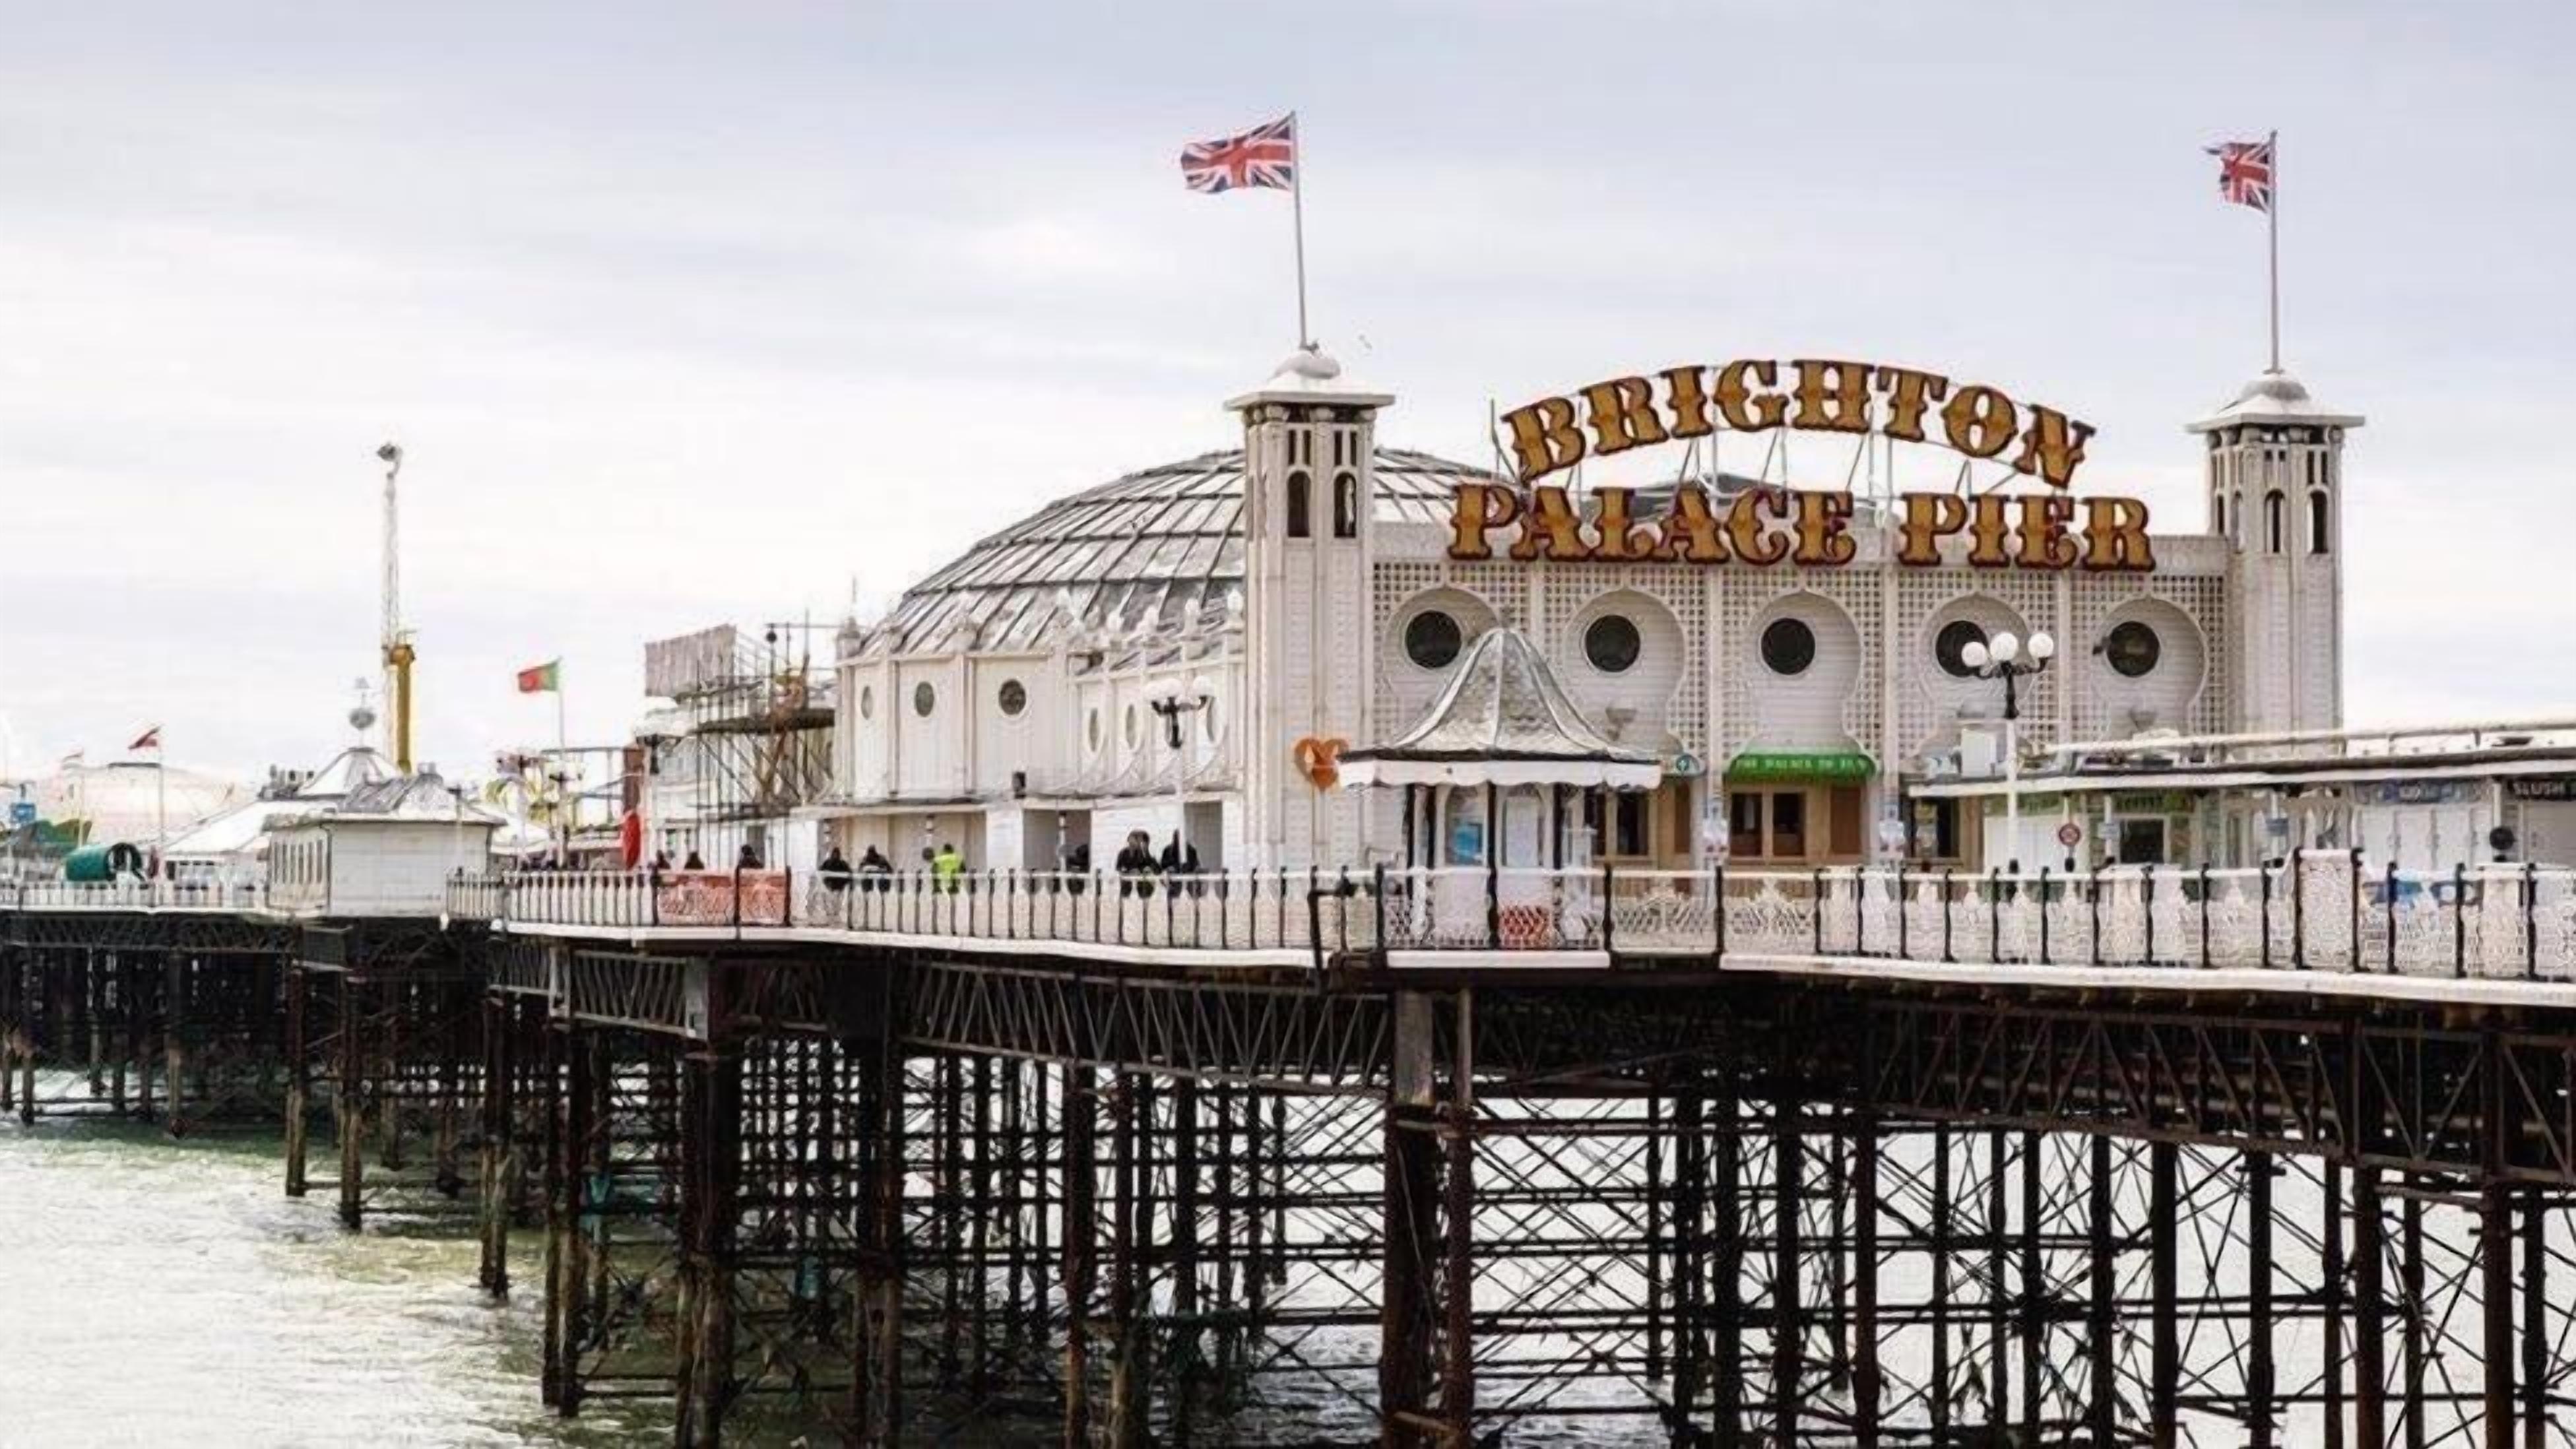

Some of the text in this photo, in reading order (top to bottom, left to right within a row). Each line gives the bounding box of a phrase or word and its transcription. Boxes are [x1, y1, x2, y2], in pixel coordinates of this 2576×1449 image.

[1501, 360, 2096, 488] BRIGHTON
[1448, 483, 2156, 571] PALACE PIER
